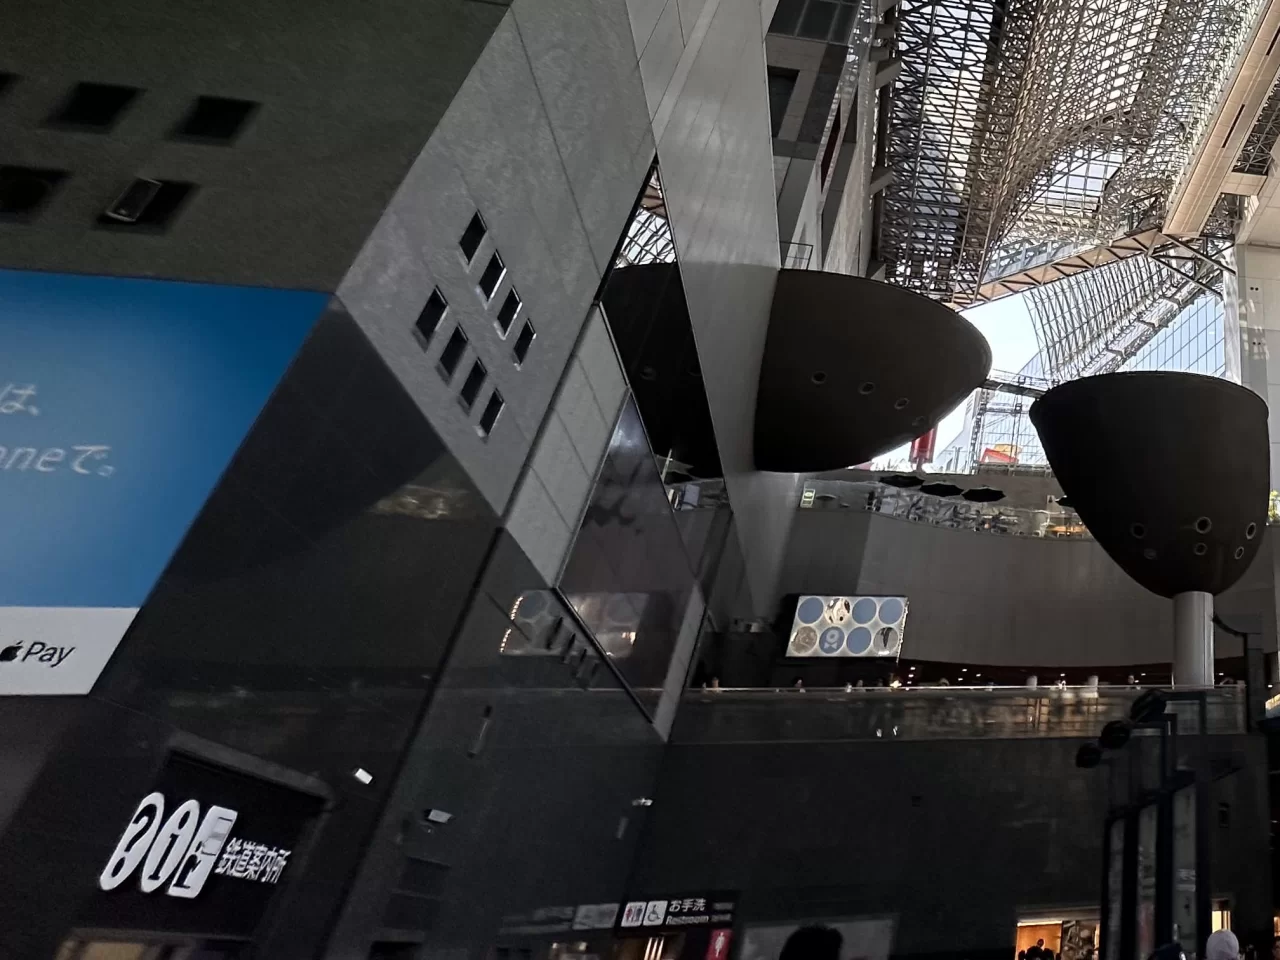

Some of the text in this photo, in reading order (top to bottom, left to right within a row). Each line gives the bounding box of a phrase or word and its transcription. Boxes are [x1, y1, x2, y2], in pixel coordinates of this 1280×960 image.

[21, 641, 76, 668] Pay
[214, 837, 292, 884] 鉄道案内所
